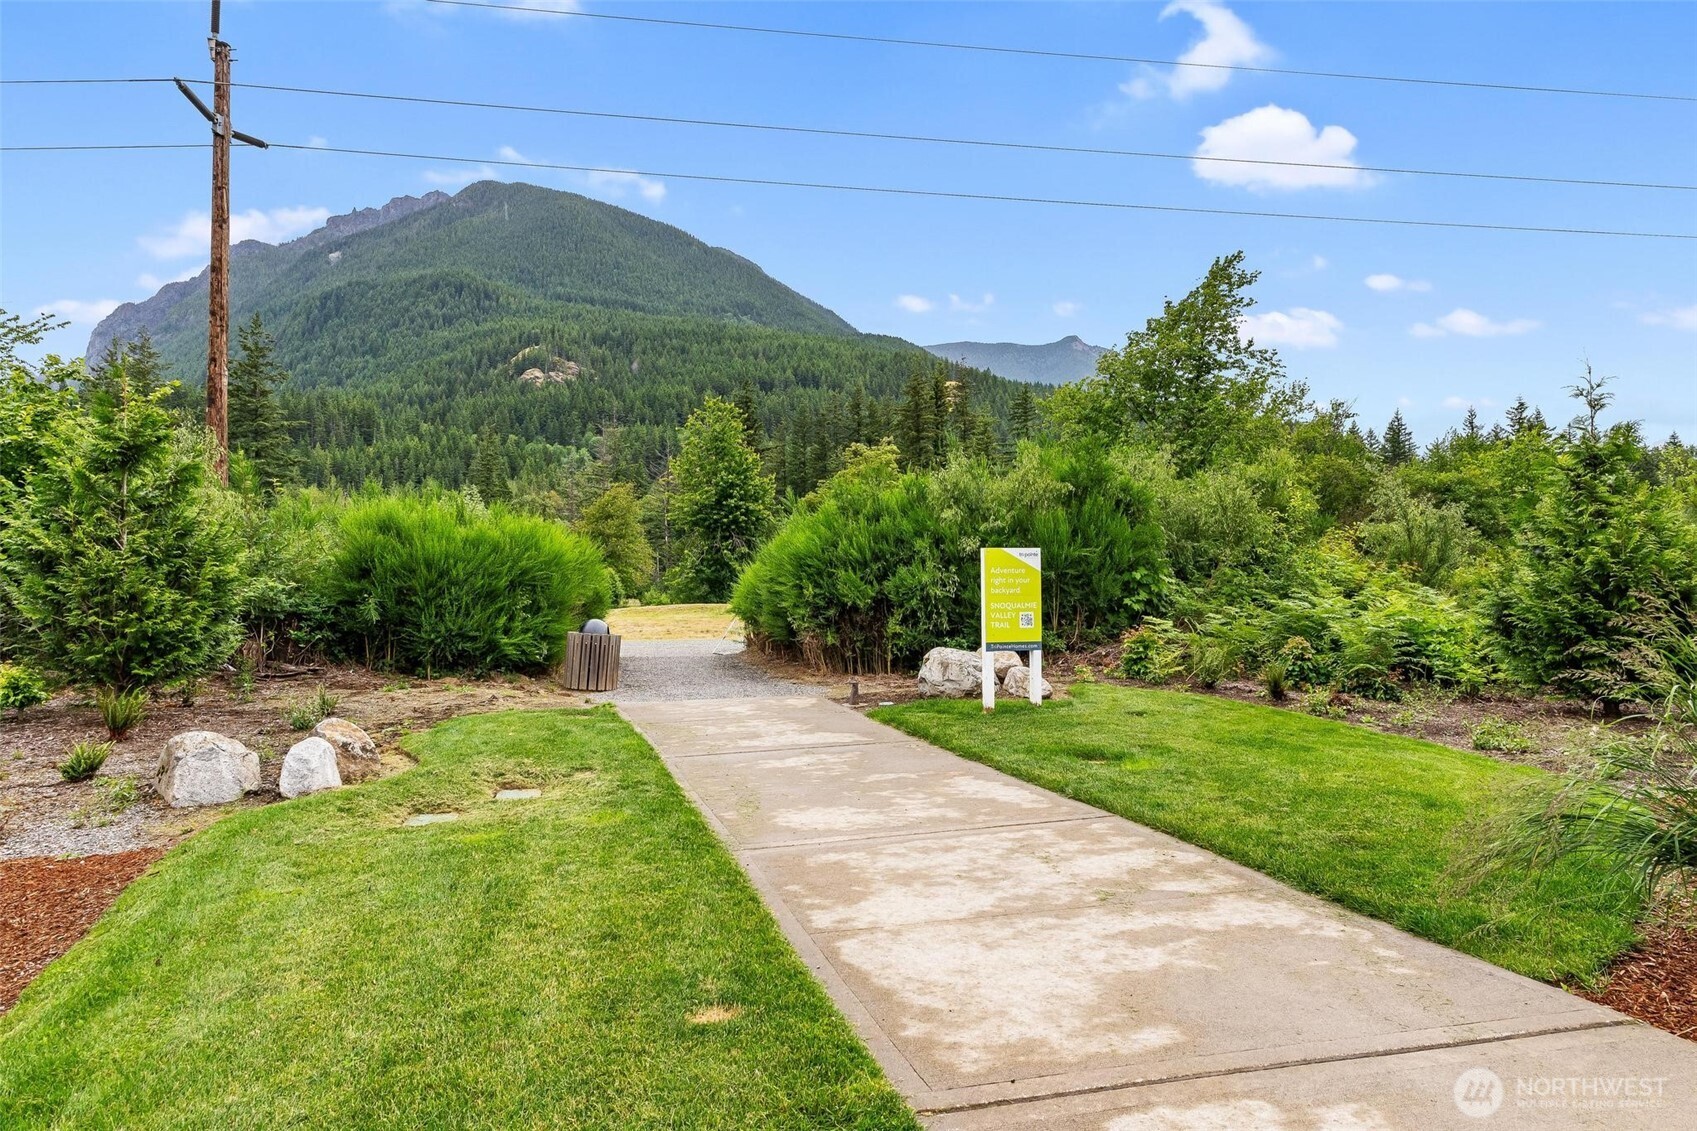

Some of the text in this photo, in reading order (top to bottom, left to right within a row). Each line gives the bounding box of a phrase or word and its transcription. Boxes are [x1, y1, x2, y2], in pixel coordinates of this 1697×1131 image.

[990, 577, 1006, 586] right
[1015, 578, 1030, 586] your
[990, 602, 1037, 610] SNOQUALMIE
